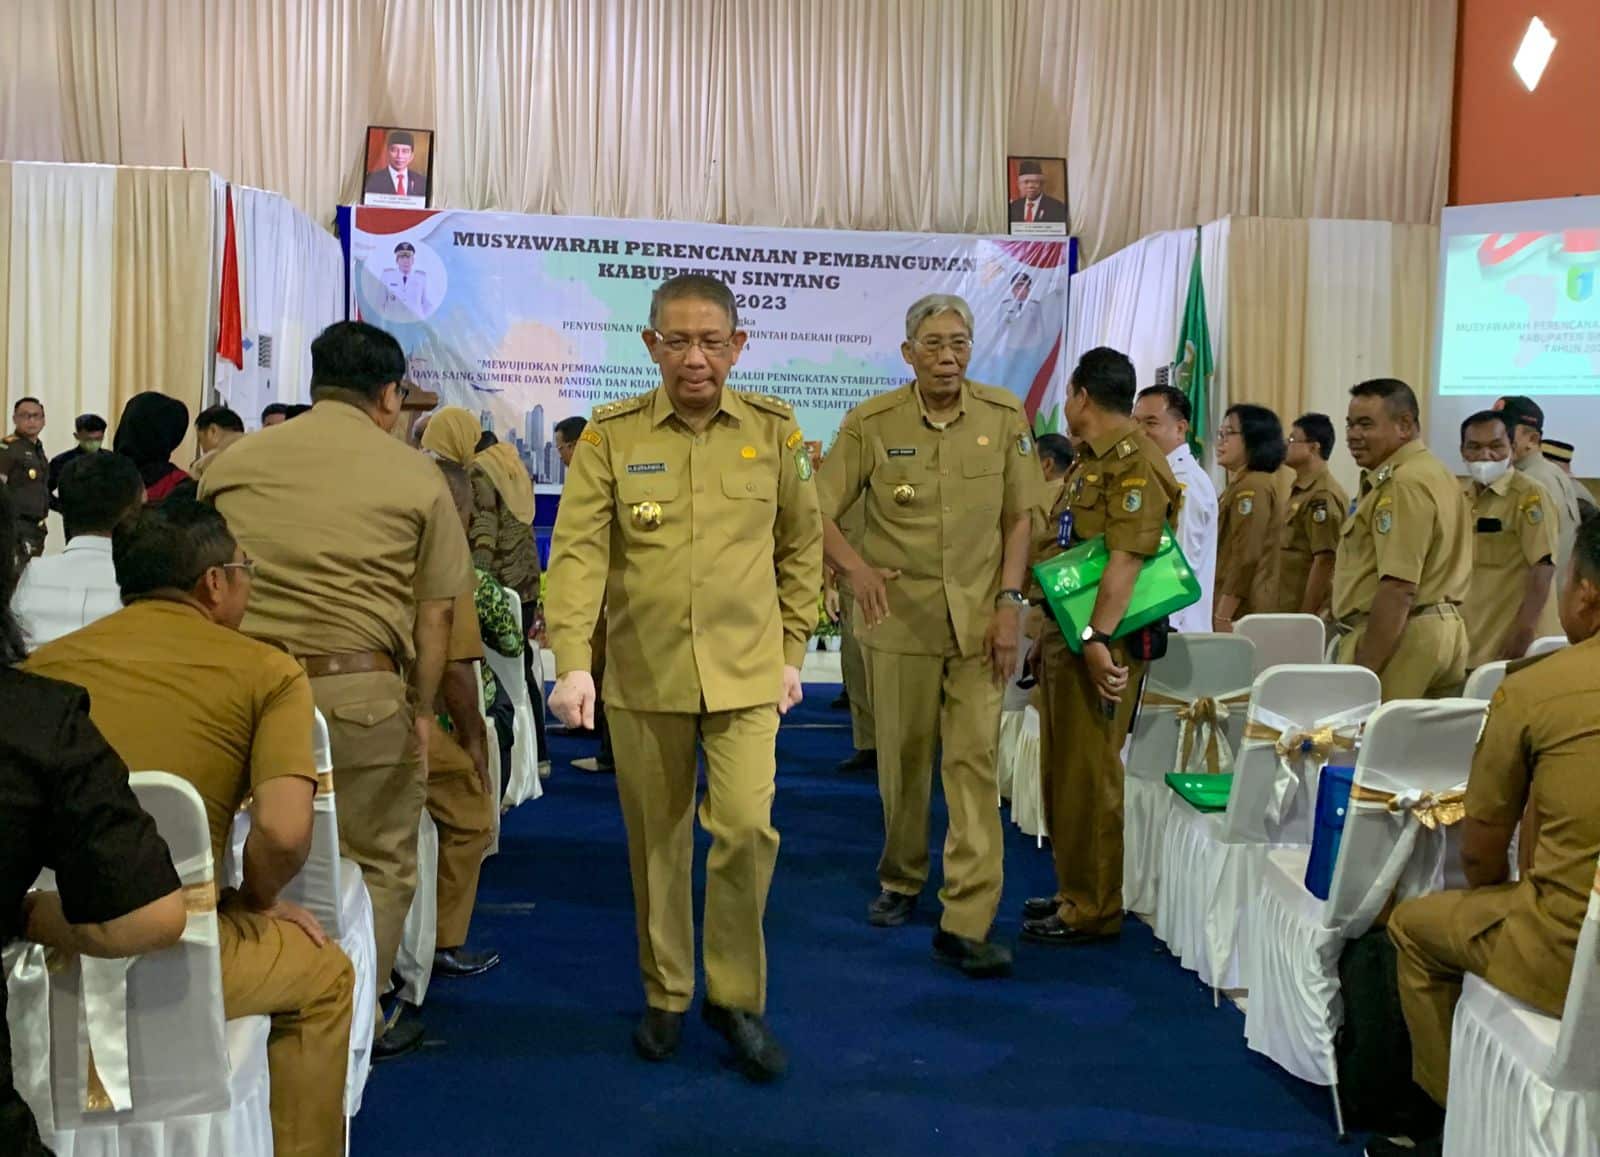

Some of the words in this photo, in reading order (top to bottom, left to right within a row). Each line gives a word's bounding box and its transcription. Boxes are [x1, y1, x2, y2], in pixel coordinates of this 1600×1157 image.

[453, 231, 619, 255] MUSYAWARAH
[625, 240, 797, 265] PERENCANAAN
[802, 250, 977, 273] PEMBANGUNAN
[742, 271, 840, 289] SINTANG
[735, 294, 787, 310] 2023
[562, 320, 633, 333] PENYUSUNAN
[750, 330, 788, 341] RINTAH
[790, 332, 832, 343] DAERAH
[835, 333, 872, 345] (RKPD)
[1533, 319, 1600, 331] PERENCANA
[413, 369, 439, 380] DAYA
[442, 370, 474, 381] SAING
[477, 372, 522, 383] SUMBER
[524, 374, 551, 384] DAYA
[554, 376, 602, 386] MANUSIA
[605, 378, 627, 388] DAN
[771, 385, 802, 395] SERTA
[803, 386, 829, 396] TATA
[831, 387, 870, 397] KELOLA
[561, 363, 643, 375] PEMBANGUNAN
[728, 371, 764, 381] ELALUI
[767, 372, 839, 384] PENINGKATAN
[840, 375, 897, 386] STABILITAS
[559, 388, 601, 400] MENUJU
[812, 400, 858, 410] SEJAHTE
